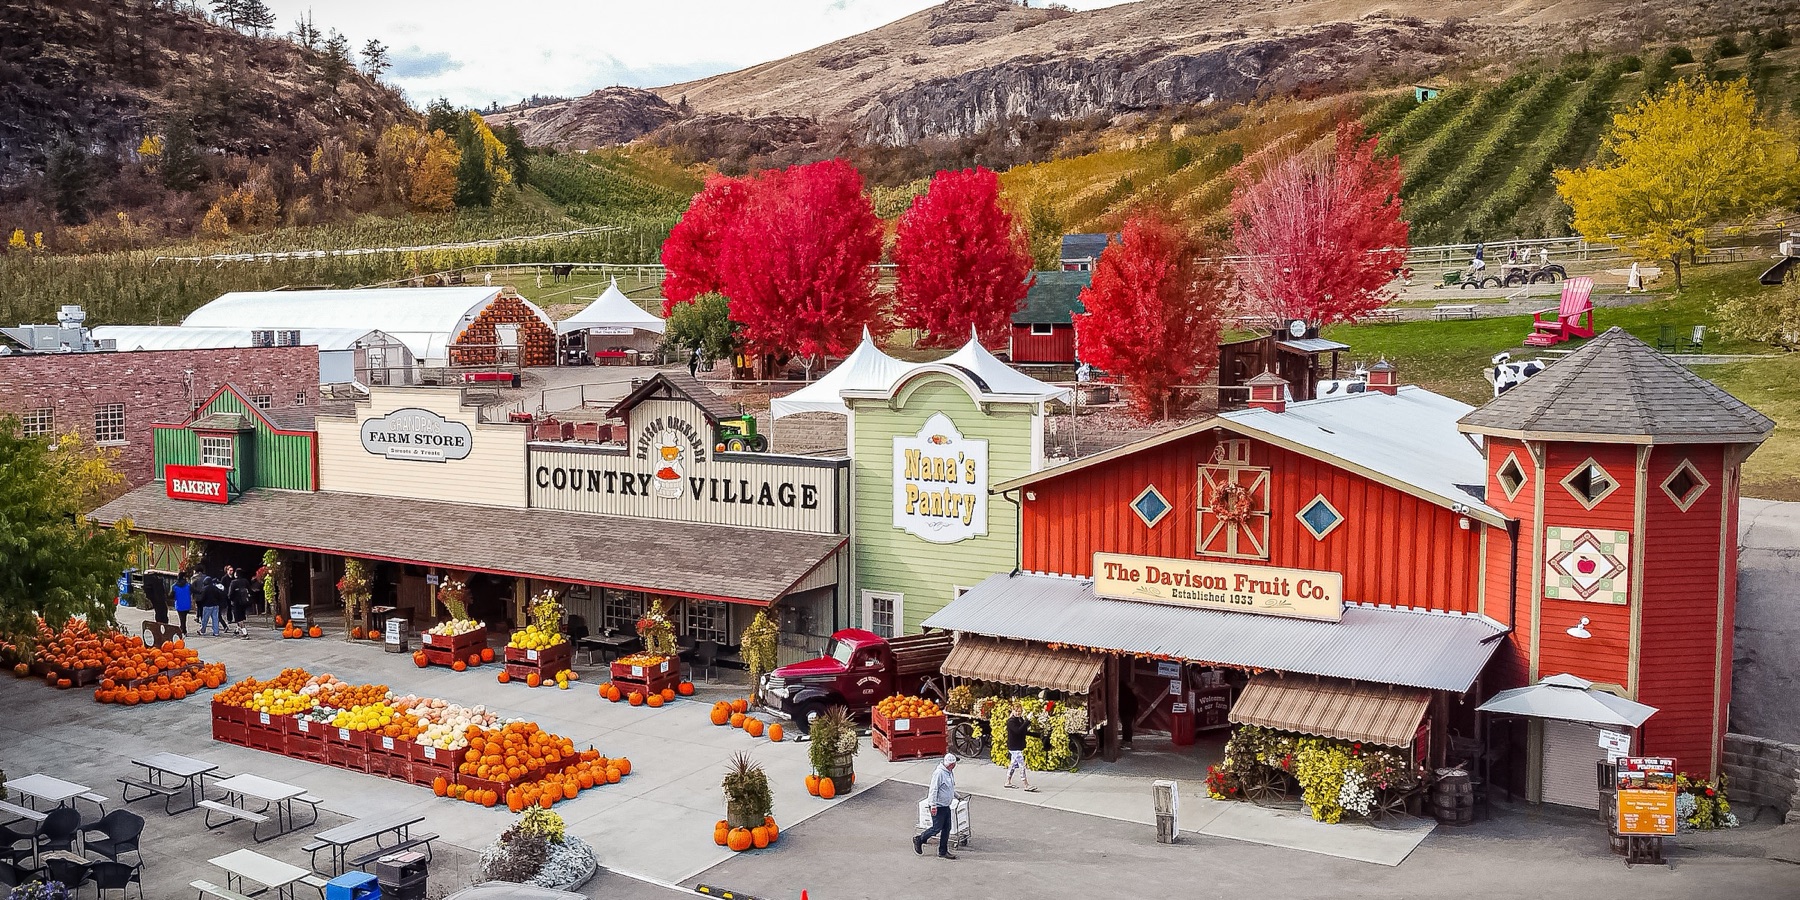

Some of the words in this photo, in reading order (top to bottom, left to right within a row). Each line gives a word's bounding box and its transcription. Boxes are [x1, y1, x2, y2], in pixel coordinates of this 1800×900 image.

[389, 415, 441, 433] GRANDPA'S
[369, 431, 410, 444] FARM
[414, 434, 465, 447] STORE
[637, 417, 664, 460] DAVISON
[668, 415, 706, 463] ORCHARDS
[904, 449, 976, 484] Nana's
[172, 479, 221, 496] BAKERY
[536, 466, 652, 497] COUNTRY
[689, 477, 818, 509] VILLAGE
[905, 483, 977, 526] Pantry
[1104, 562, 1140, 582] The
[1145, 566, 1228, 591] Davison
[1233, 573, 1290, 597] Fruit
[1296, 579, 1330, 601] Co.
[1171, 588, 1226, 603] Established
[1229, 594, 1253, 605] 1933
[1199, 696, 1226, 705] Welcome
